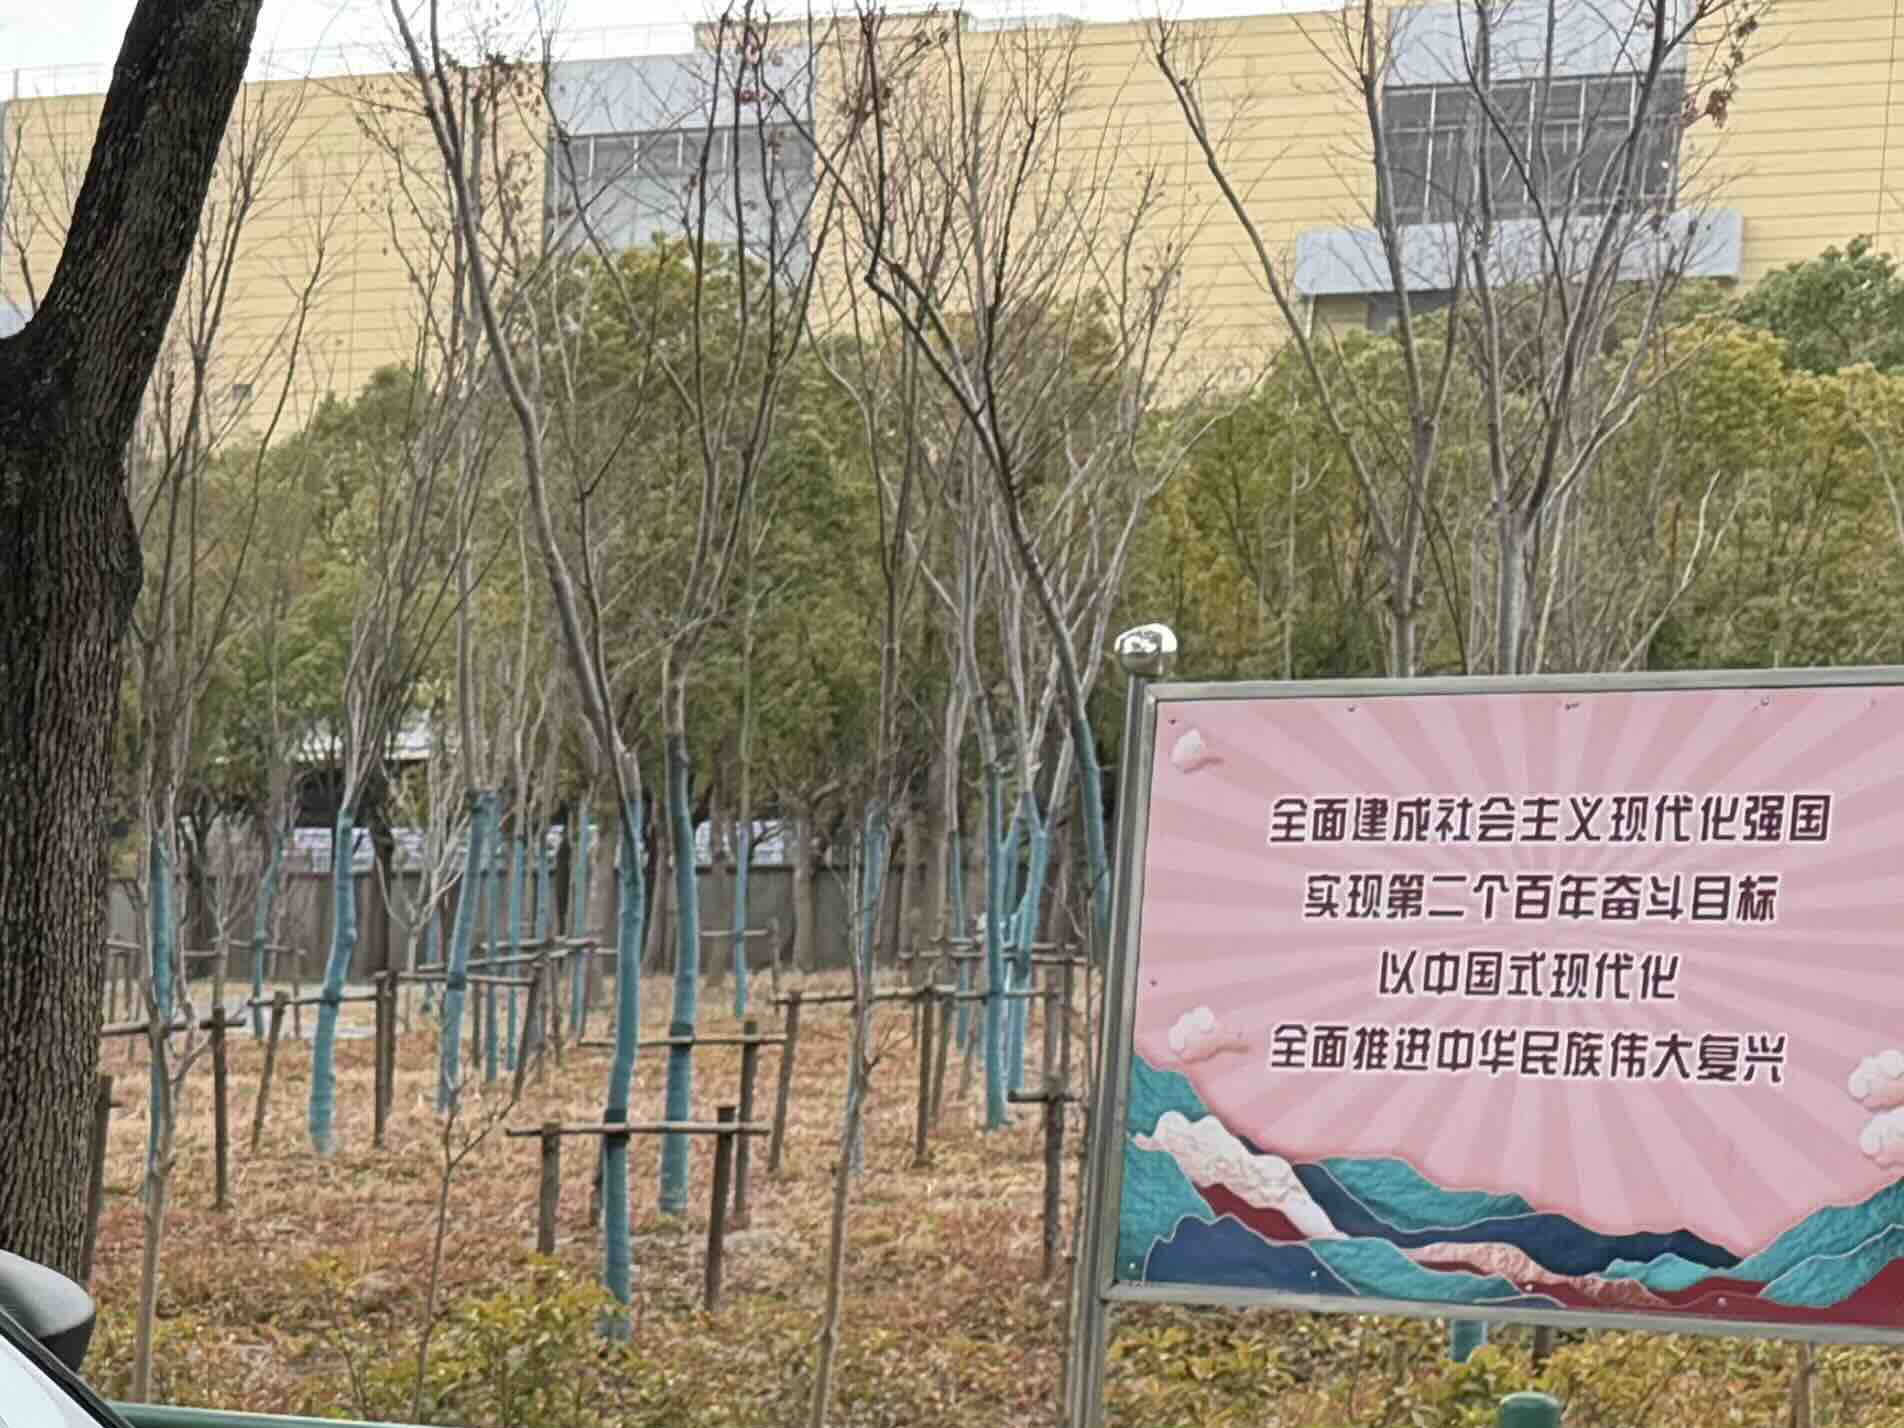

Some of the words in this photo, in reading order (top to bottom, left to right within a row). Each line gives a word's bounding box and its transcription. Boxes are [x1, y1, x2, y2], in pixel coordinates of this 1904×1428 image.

[1270, 794, 1831, 842] 全面建成社会主义现代化强国
[1305, 874, 1778, 921] 实现第二个百年奋斗目标
[1379, 950, 1678, 999] 以中国式现代化
[1271, 1024, 1785, 1083] 全面推进中华民族伟大复兴
